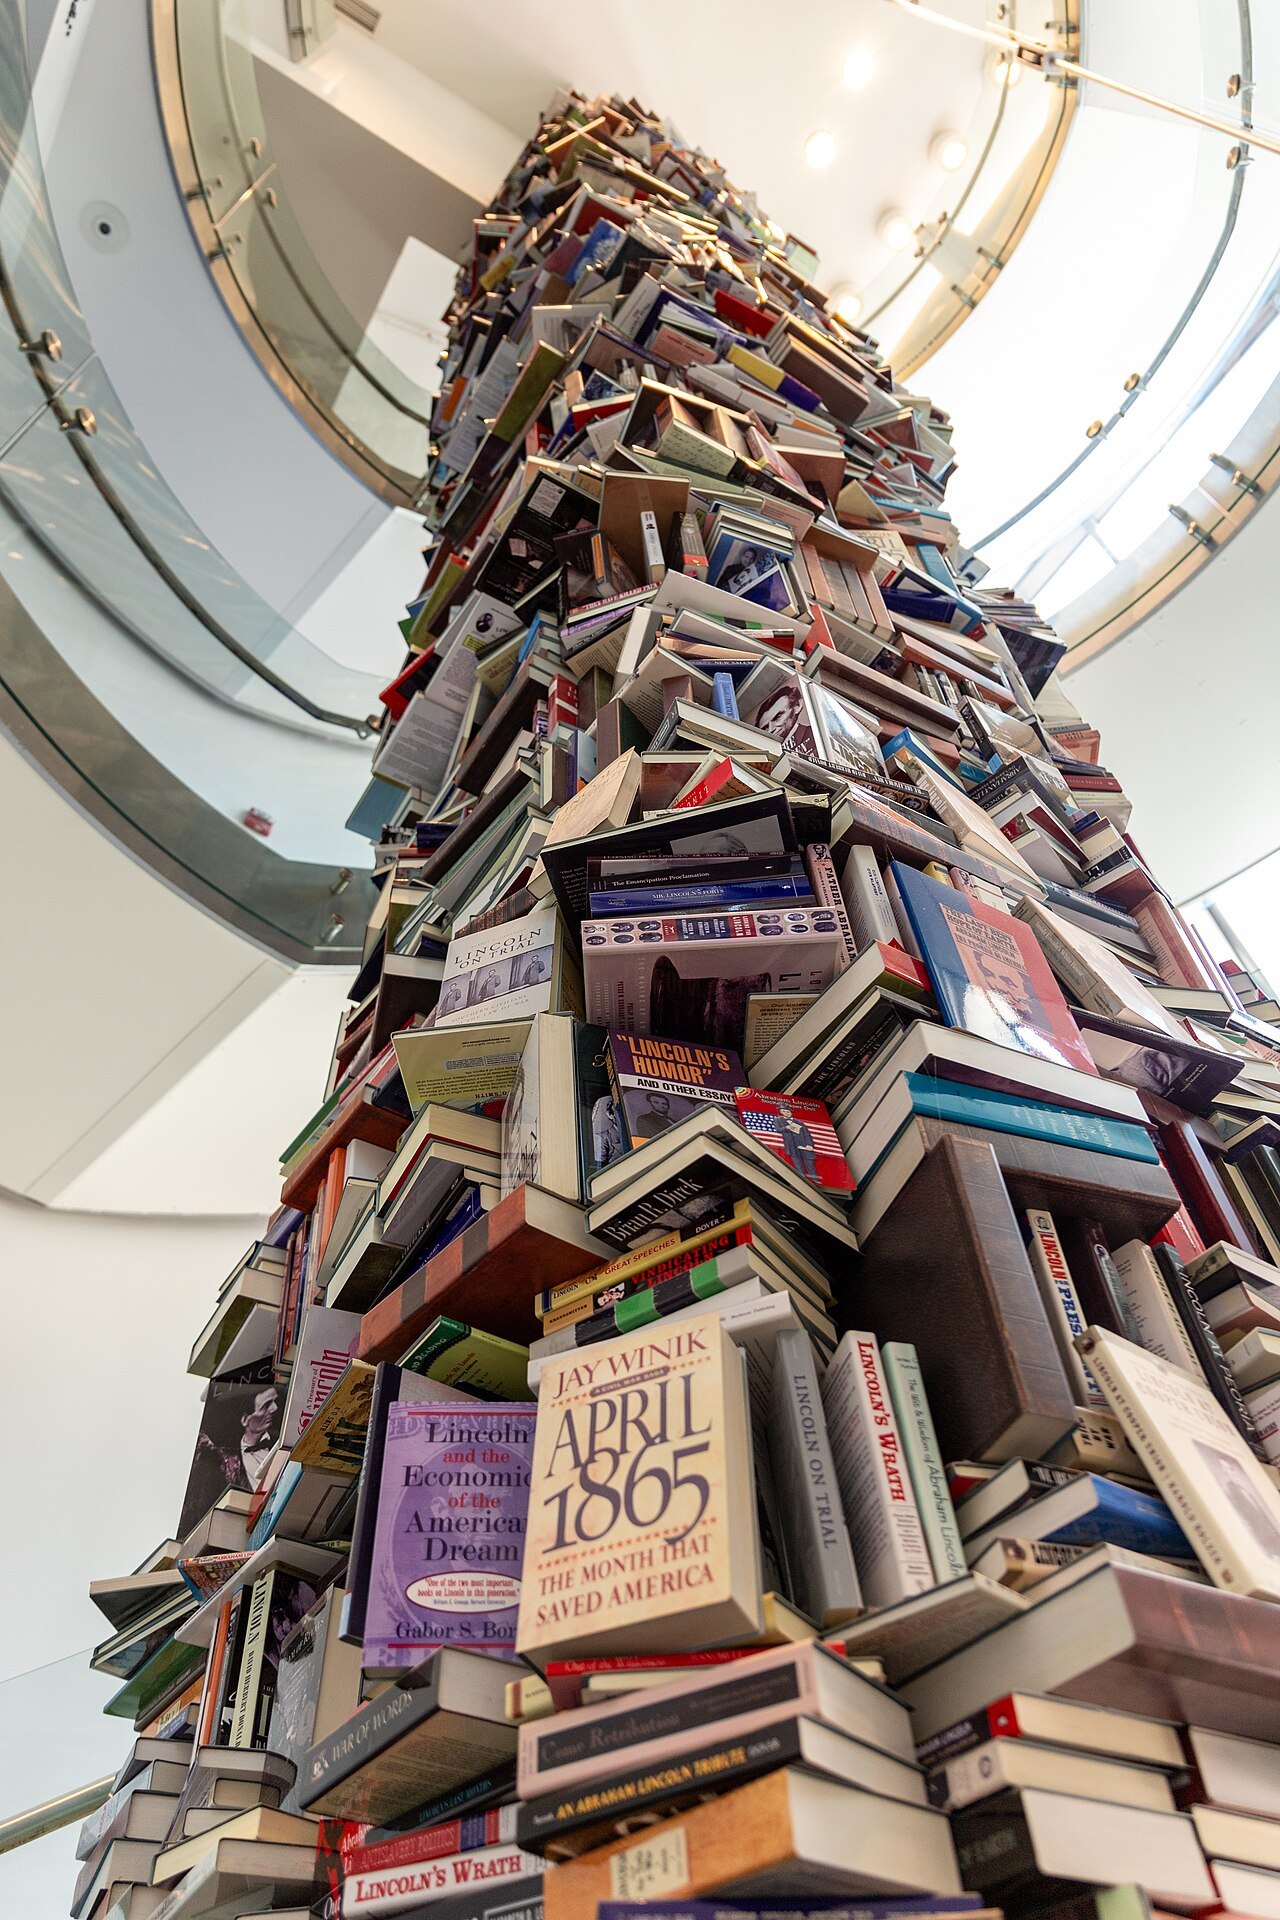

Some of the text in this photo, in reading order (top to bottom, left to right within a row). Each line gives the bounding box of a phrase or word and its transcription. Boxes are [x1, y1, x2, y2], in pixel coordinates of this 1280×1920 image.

[929, 790, 948, 815] Lincoln
[625, 876, 668, 886] Emancipation
[669, 872, 709, 881] Proclamation
[733, 916, 743, 936] LINCOLN
[825, 867, 857, 962] FATHER ABRAHAM
[947, 914, 1016, 951] HOPE OF EARTH
[965, 914, 989, 931] LAST
[990, 927, 1013, 943] BEST
[455, 928, 542, 964] LINCOLN
[460, 940, 534, 968] ON TRIAL
[956, 926, 1016, 959] ABRAHAM LINCOLN
[1035, 920, 1049, 937] Inside
[1059, 948, 1075, 966] White
[1071, 960, 1086, 979] House
[815, 1041, 856, 1083] THE LINCOLNS
[637, 1078, 736, 1103] AND OTHER ESSAYS
[754, 1093, 821, 1108] Abraham Lincoln
[602, 1176, 704, 1243] Brian R. Dirck
[694, 1218, 720, 1234] DOVER
[553, 1238, 676, 1299] LINCOLN GREAT SPEECHES
[630, 1235, 730, 1285] VINDICATING
[648, 1252, 714, 1288] LINCOLN
[1040, 1231, 1068, 1279] LINCOLN
[1150, 1261, 1170, 1298] LINCOLN
[549, 1304, 588, 1323] KRANNAWITTER
[414, 1336, 449, 1362] READING
[553, 1328, 708, 1400] JAY WINIK
[1176, 1264, 1212, 1334] LINCOLN
[1207, 1336, 1225, 1361] AT
[1220, 1364, 1255, 1431] PEORIA
[312, 1368, 320, 1377] of
[602, 1381, 620, 1393] CIVIL
[622, 1376, 640, 1386] WAR
[643, 1368, 665, 1381] SAGA
[907, 1378, 917, 1392] The
[308, 1378, 317, 1405] Treasury
[425, 1421, 529, 1444] Lincoln
[544, 1371, 713, 1479] APRIL
[916, 1418, 930, 1451] Wisdom
[443, 1449, 510, 1464] and the
[793, 1374, 839, 1549] LINCOLN ON TRIAL
[879, 1432, 907, 1503] WRATH
[922, 1450, 934, 1464] of
[448, 1492, 501, 1509] of the
[542, 1436, 710, 1554] 1865
[928, 1464, 950, 1523] Abraham
[422, 1536, 519, 1562] Dream
[538, 1532, 714, 1597] THE MONTH THAT
[940, 1527, 961, 1577] Lincoln
[418, 1588, 433, 1596] books
[444, 1588, 464, 1596] Lincoln
[475, 1588, 485, 1596] this
[535, 1563, 714, 1627] SAVED AMERICA
[396, 1621, 454, 1639] Gabor
[459, 1621, 477, 1638] S.
[235, 1580, 269, 1747] LINCOLN DAVID HERBERT DONALD
[332, 1688, 414, 1760] WAR OF WORDS
[542, 1714, 682, 1763] Come Retribution
[556, 1746, 748, 1821] AN ABRAHAM LINCOLN TRIBUTE
[360, 1828, 457, 1870] ANTISLAVERY POLITICS
[452, 1854, 522, 1884] WRATH
